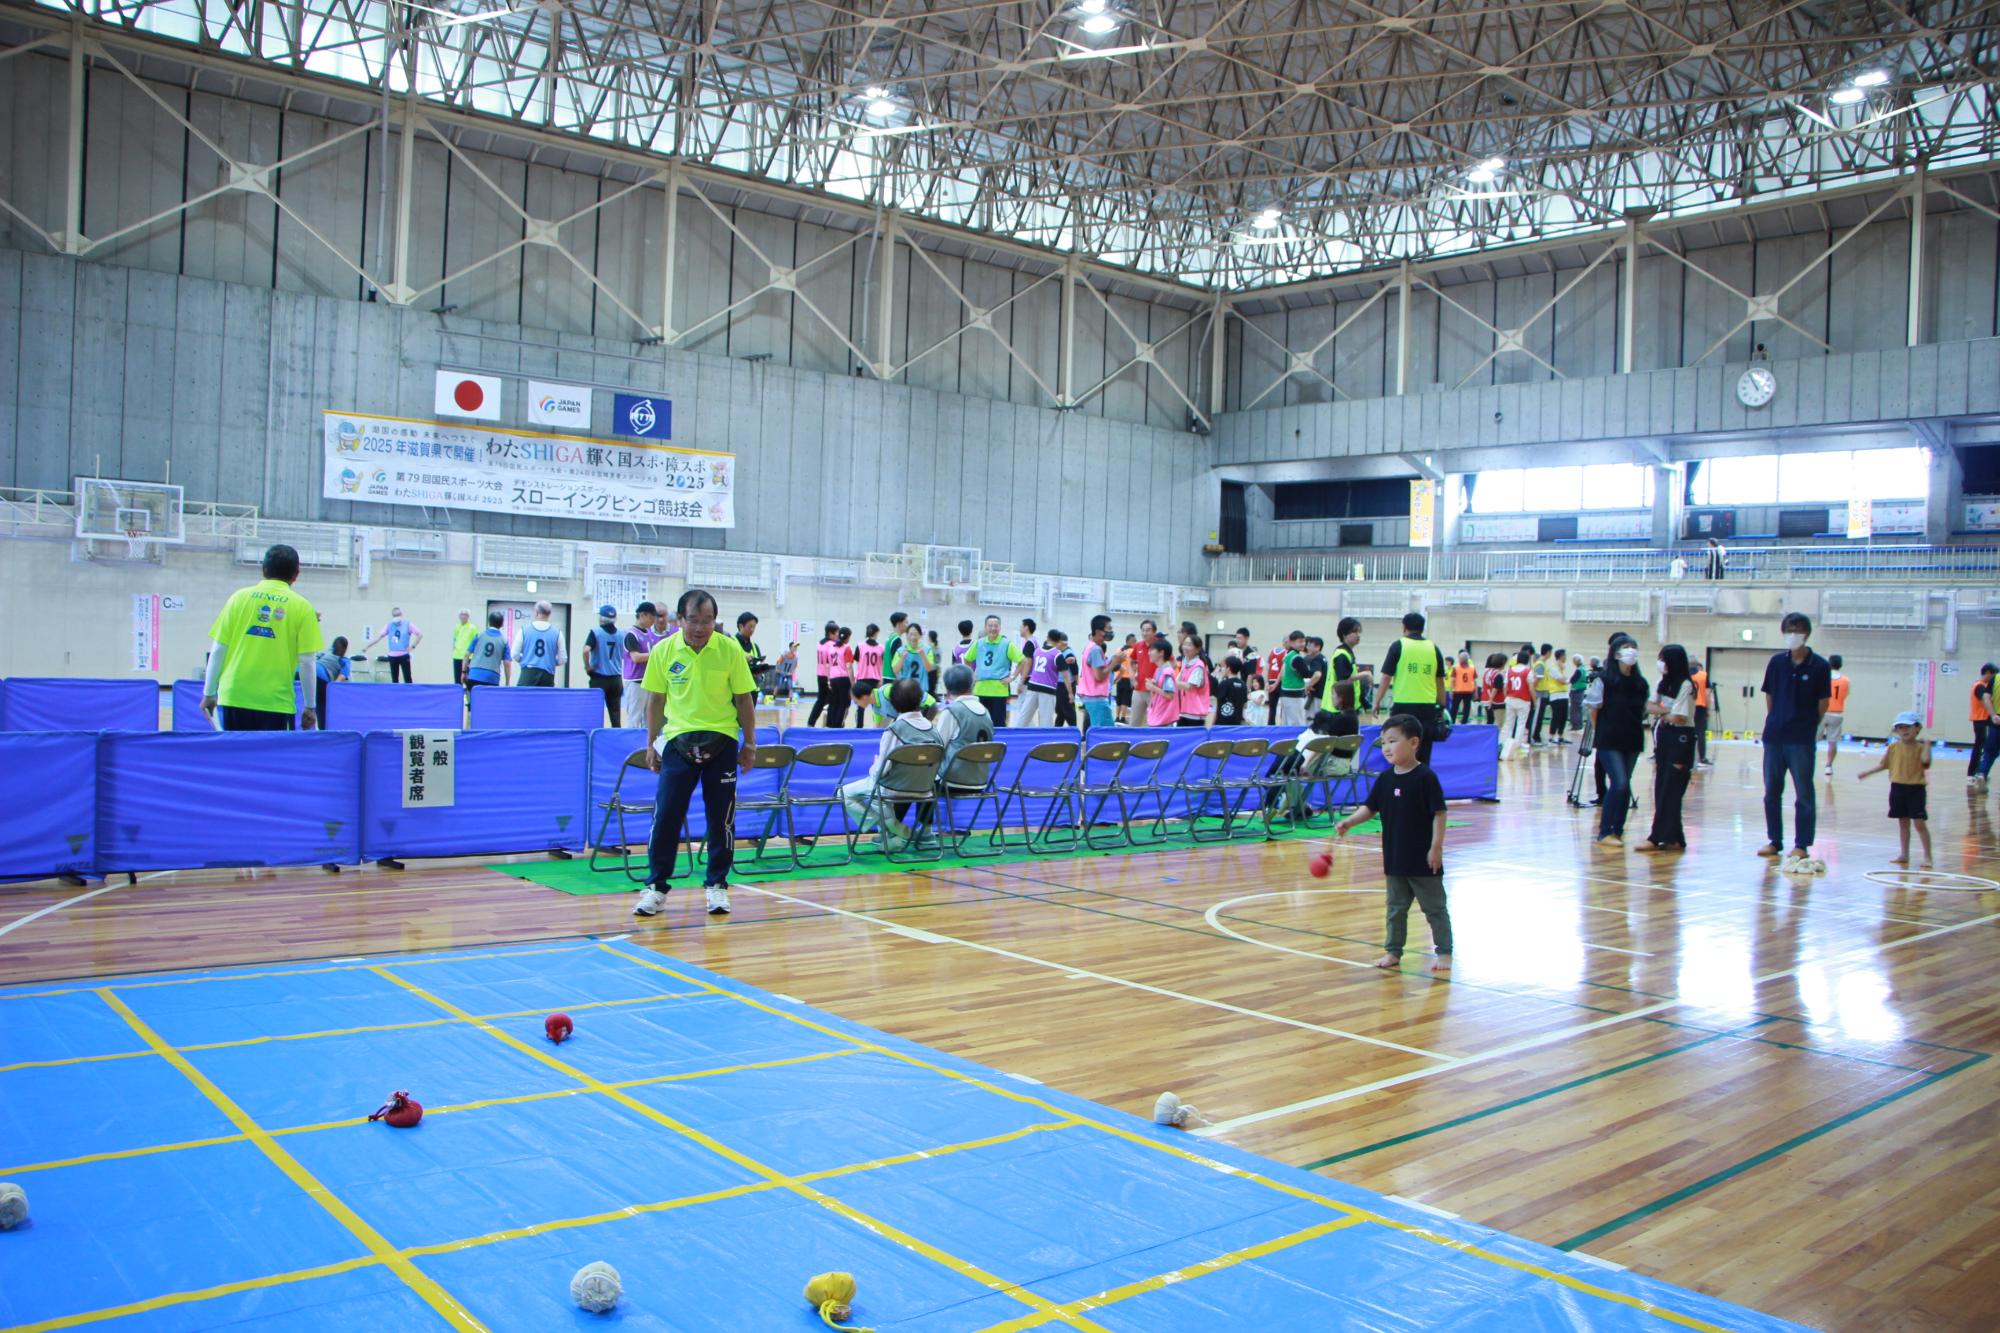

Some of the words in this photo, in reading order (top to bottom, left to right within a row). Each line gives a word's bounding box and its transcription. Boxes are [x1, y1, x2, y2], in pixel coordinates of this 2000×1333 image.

[557, 399, 581, 407] JAPAN
[513, 479, 607, 494] デモンストレーションスポーツ
[665, 473, 705, 490] 2025
[482, 495, 503, 505] 2025
[511, 487, 704, 519] スローイングビンゴ競技会
[250, 591, 289, 603] BINGO
[484, 641, 495, 658] 9
[534, 638, 545, 658] 8
[606, 641, 616, 660] 7
[865, 651, 878, 667] 10
[984, 651, 994, 667] 3
[1034, 655, 1047, 673] 12
[1271, 658, 1280, 671] 2
[910, 661, 919, 678] 2
[1407, 662, 1432, 676] 報道
[1462, 672, 1469, 683] 6
[1510, 676, 1522, 691] 10
[1834, 685, 1839, 698] 1
[432, 738, 449, 766] 一般
[408, 734, 425, 802] 観覧者席
